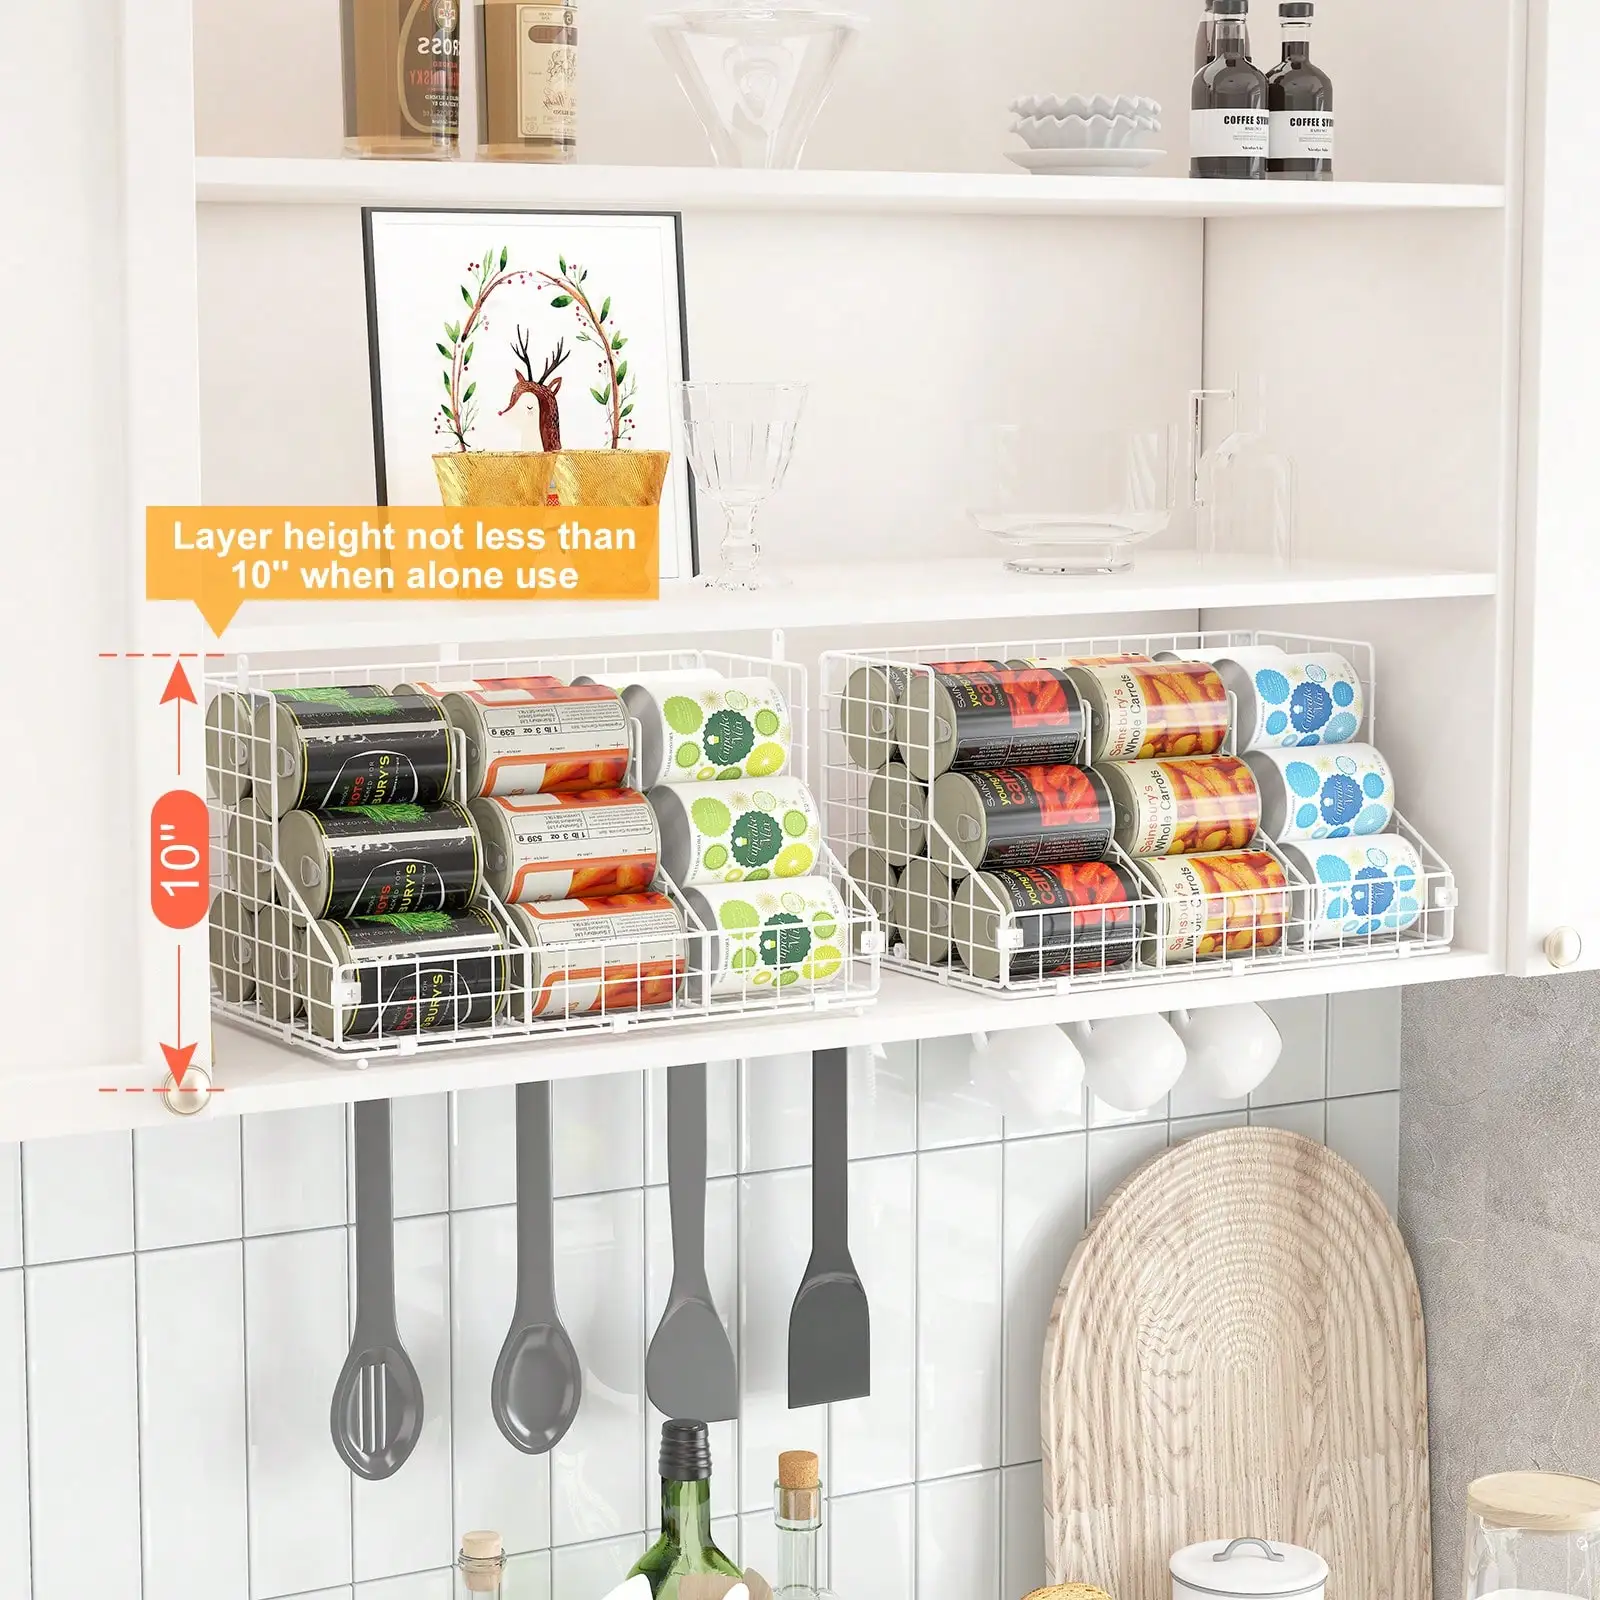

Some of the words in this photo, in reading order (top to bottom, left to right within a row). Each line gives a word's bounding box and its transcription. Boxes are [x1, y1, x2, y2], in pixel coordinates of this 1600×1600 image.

[1223, 115, 1254, 125] COFFEE
[1289, 117, 1320, 127] COFFEE
[1121, 674, 1141, 714] Carrots
[1301, 688, 1313, 731] Cupcake
[1314, 691, 1324, 715] Mix
[491, 728, 497, 736] g
[500, 728, 515, 736] 539
[718, 714, 730, 763] Cupcake
[732, 720, 743, 748] Mix
[1109, 688, 1128, 757] Sainsbury's
[1123, 719, 1142, 755] Whole
[989, 777, 1012, 806] young
[1151, 769, 1171, 811] Carrots
[1332, 779, 1343, 823] Cupcake
[746, 816, 758, 865] Cupcake
[760, 822, 772, 849] Mix
[1155, 816, 1172, 851] Whole
[1018, 876, 1042, 906] young
